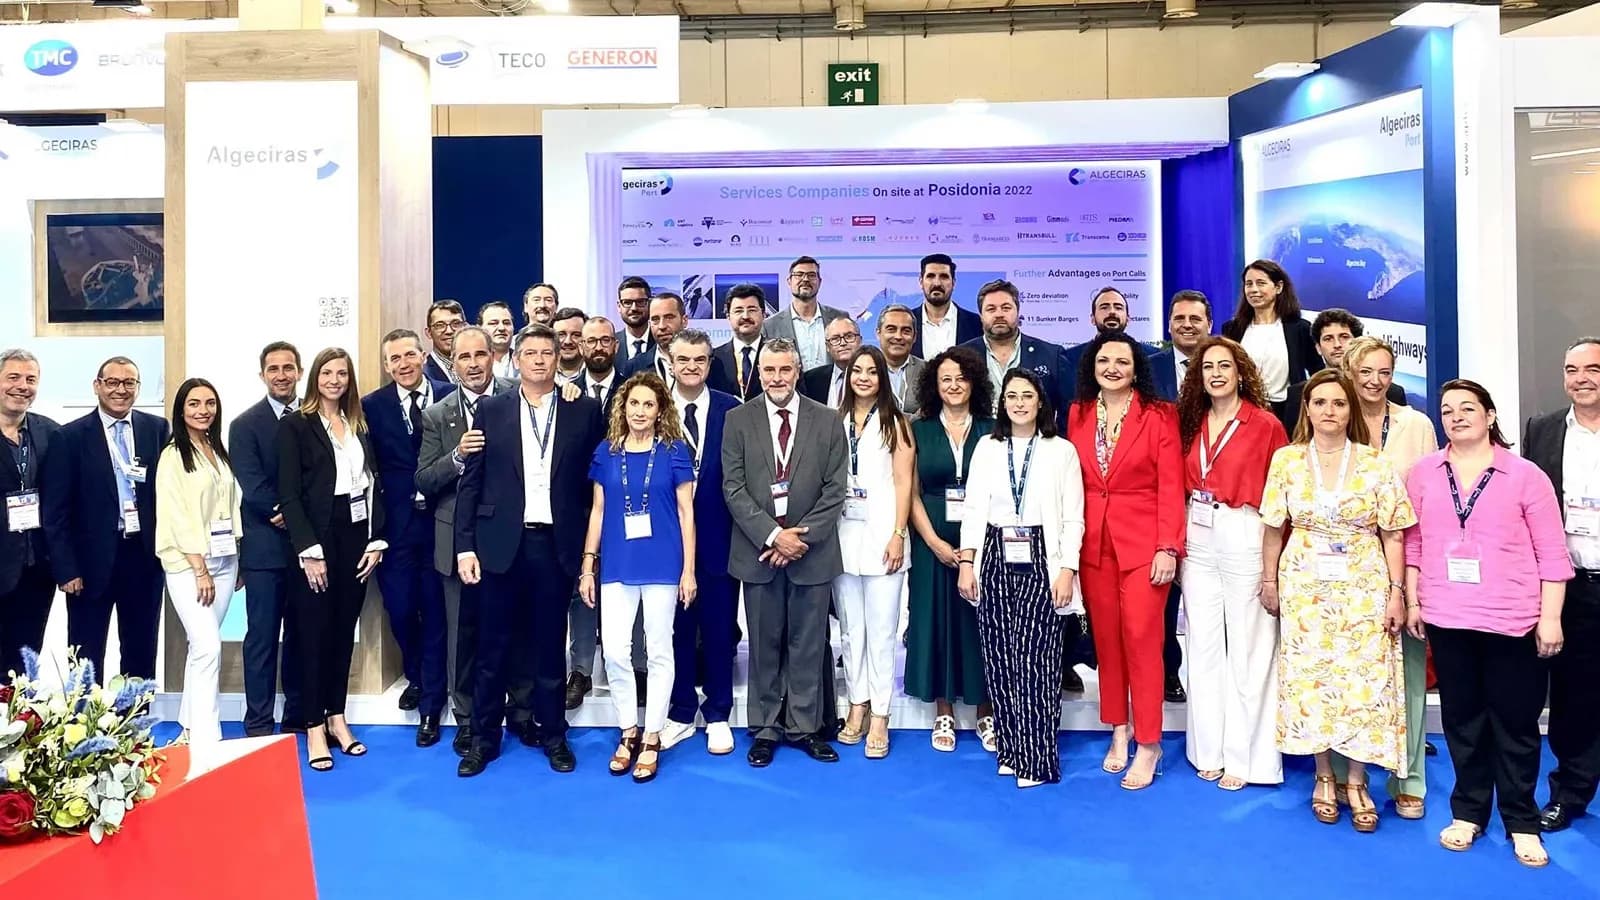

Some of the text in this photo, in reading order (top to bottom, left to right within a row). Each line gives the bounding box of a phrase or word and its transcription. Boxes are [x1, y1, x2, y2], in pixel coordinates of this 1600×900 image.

[32, 49, 73, 67] TMC
[498, 52, 546, 68] TECO
[567, 50, 657, 65] GENERON
[834, 68, 871, 82] exit
[1379, 112, 1421, 137] Algeciras
[1405, 133, 1421, 146] Port
[207, 145, 308, 168] Algeciras
[1089, 169, 1147, 180] ALGECIRAS
[622, 179, 658, 191] geciras
[720, 182, 1033, 201] Services Companies On site at Posidonia 2022
[641, 189, 658, 197] Port
[1013, 269, 1045, 278] Further
[1047, 269, 1100, 280] Advantages
[1058, 315, 1079, 323] Barges
